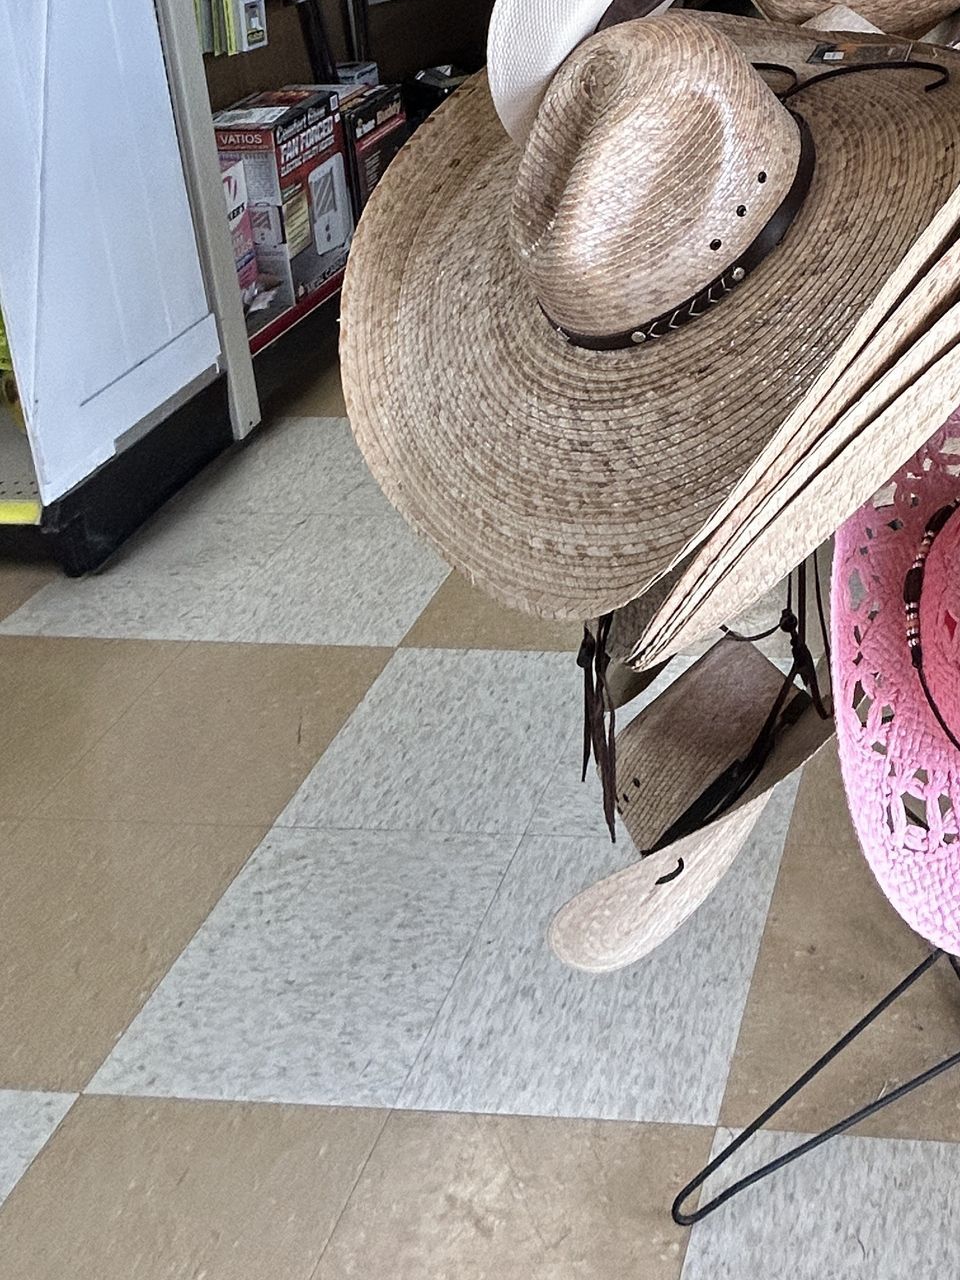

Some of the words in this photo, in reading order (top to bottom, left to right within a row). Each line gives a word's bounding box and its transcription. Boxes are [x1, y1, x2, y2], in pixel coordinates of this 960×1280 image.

[220, 133, 263, 145] VATIOS
[280, 135, 300, 165] FAN
[300, 115, 334, 152] FORCED
